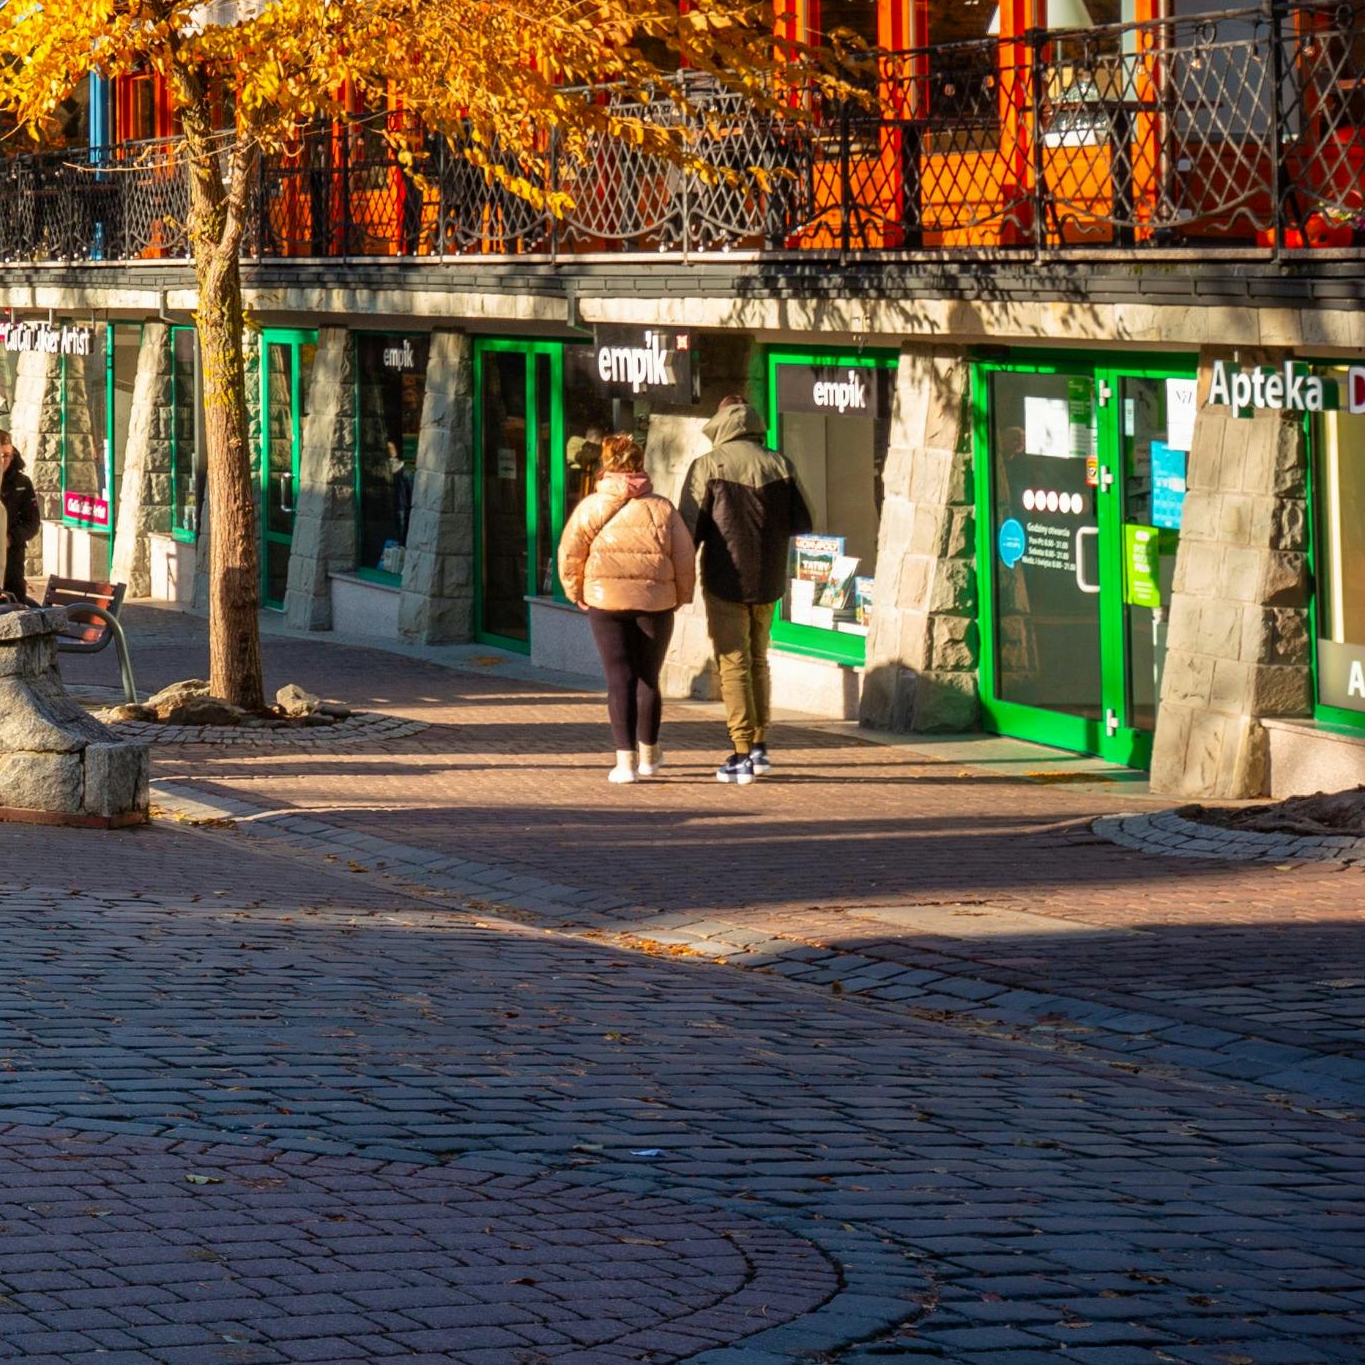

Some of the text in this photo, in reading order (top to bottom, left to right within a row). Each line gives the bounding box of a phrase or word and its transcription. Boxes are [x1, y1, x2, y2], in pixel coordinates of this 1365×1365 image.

[61, 325, 90, 355] Artist
[383, 339, 414, 372] empik
[599, 330, 670, 394] empik
[813, 369, 867, 414] empik
[1208, 359, 1325, 419] Apteka
